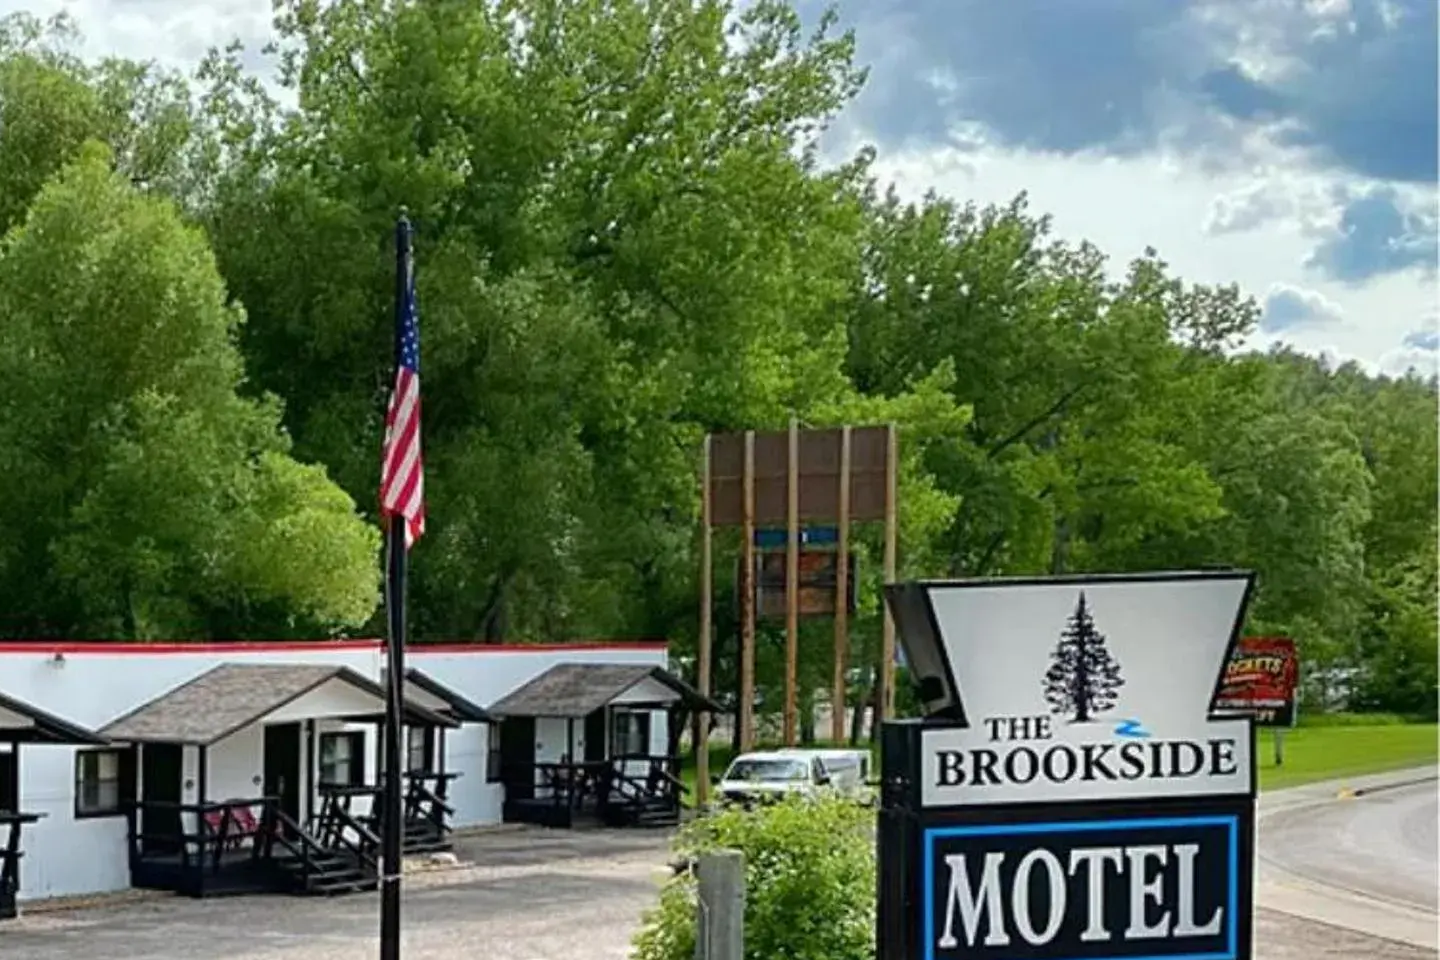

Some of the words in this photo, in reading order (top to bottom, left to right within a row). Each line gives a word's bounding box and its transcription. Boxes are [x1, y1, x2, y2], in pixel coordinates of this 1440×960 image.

[984, 715, 1052, 742] THE
[935, 739, 1239, 787] BROOKSIDE
[938, 843, 1224, 948] MOTEL
